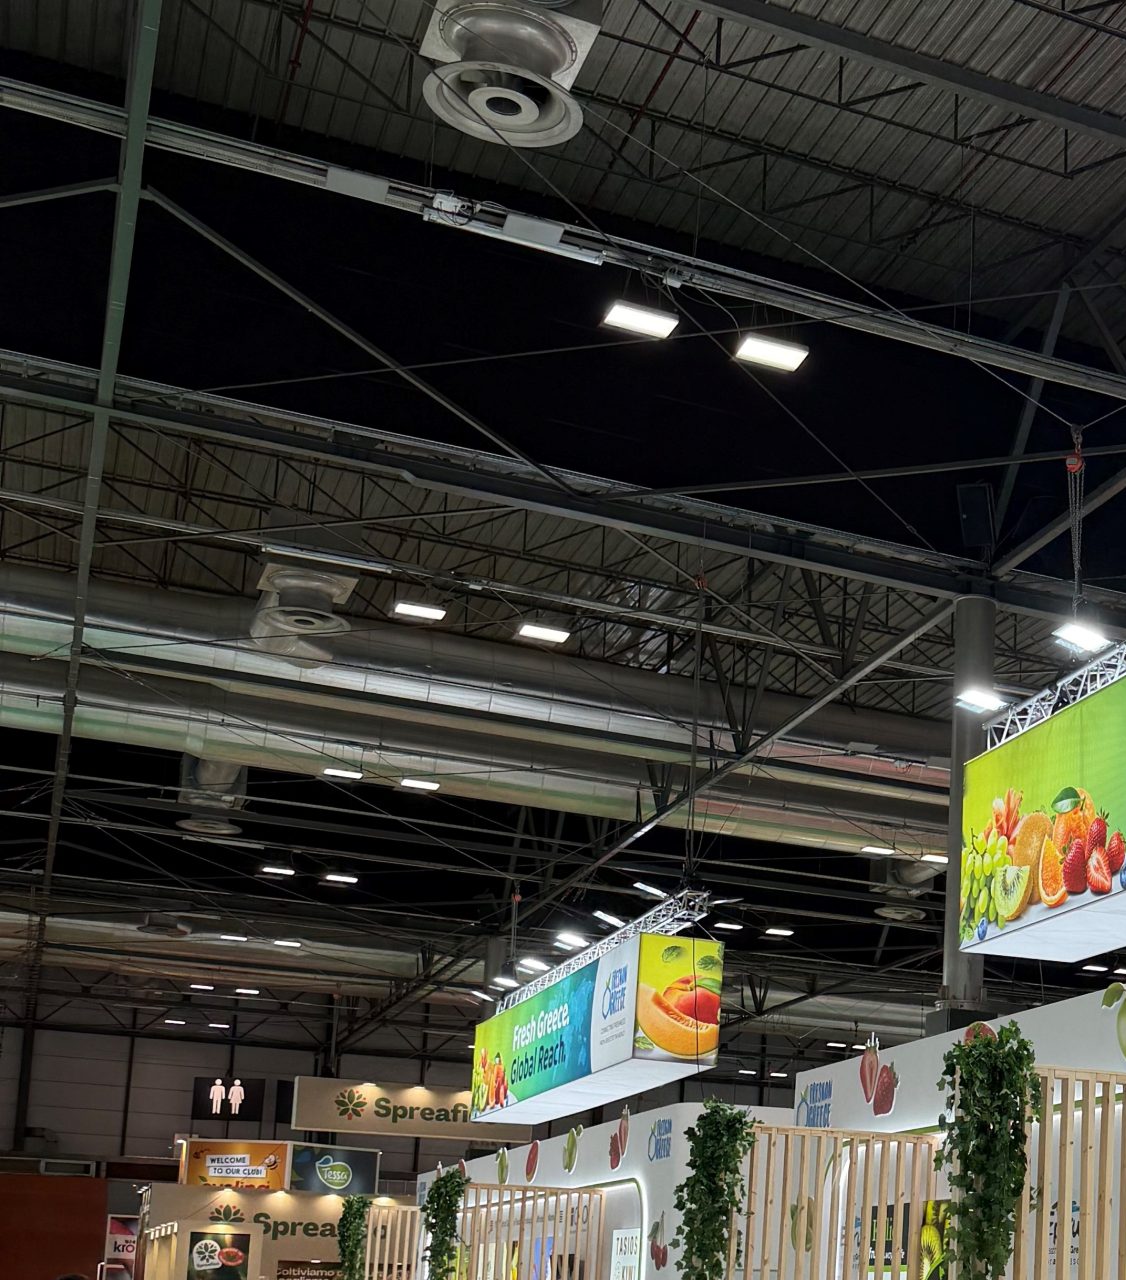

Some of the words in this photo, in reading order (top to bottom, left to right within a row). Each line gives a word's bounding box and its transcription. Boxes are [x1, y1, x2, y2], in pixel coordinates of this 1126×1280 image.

[512, 1015, 536, 1051] Fresh
[537, 1002, 570, 1039] Greece.
[511, 1047, 537, 1085] Global
[538, 1034, 566, 1073] Reach.
[374, 1097, 471, 1123] Spreafi
[322, 1167, 347, 1180] Tessa
[616, 1236, 637, 1255] TASIOS
